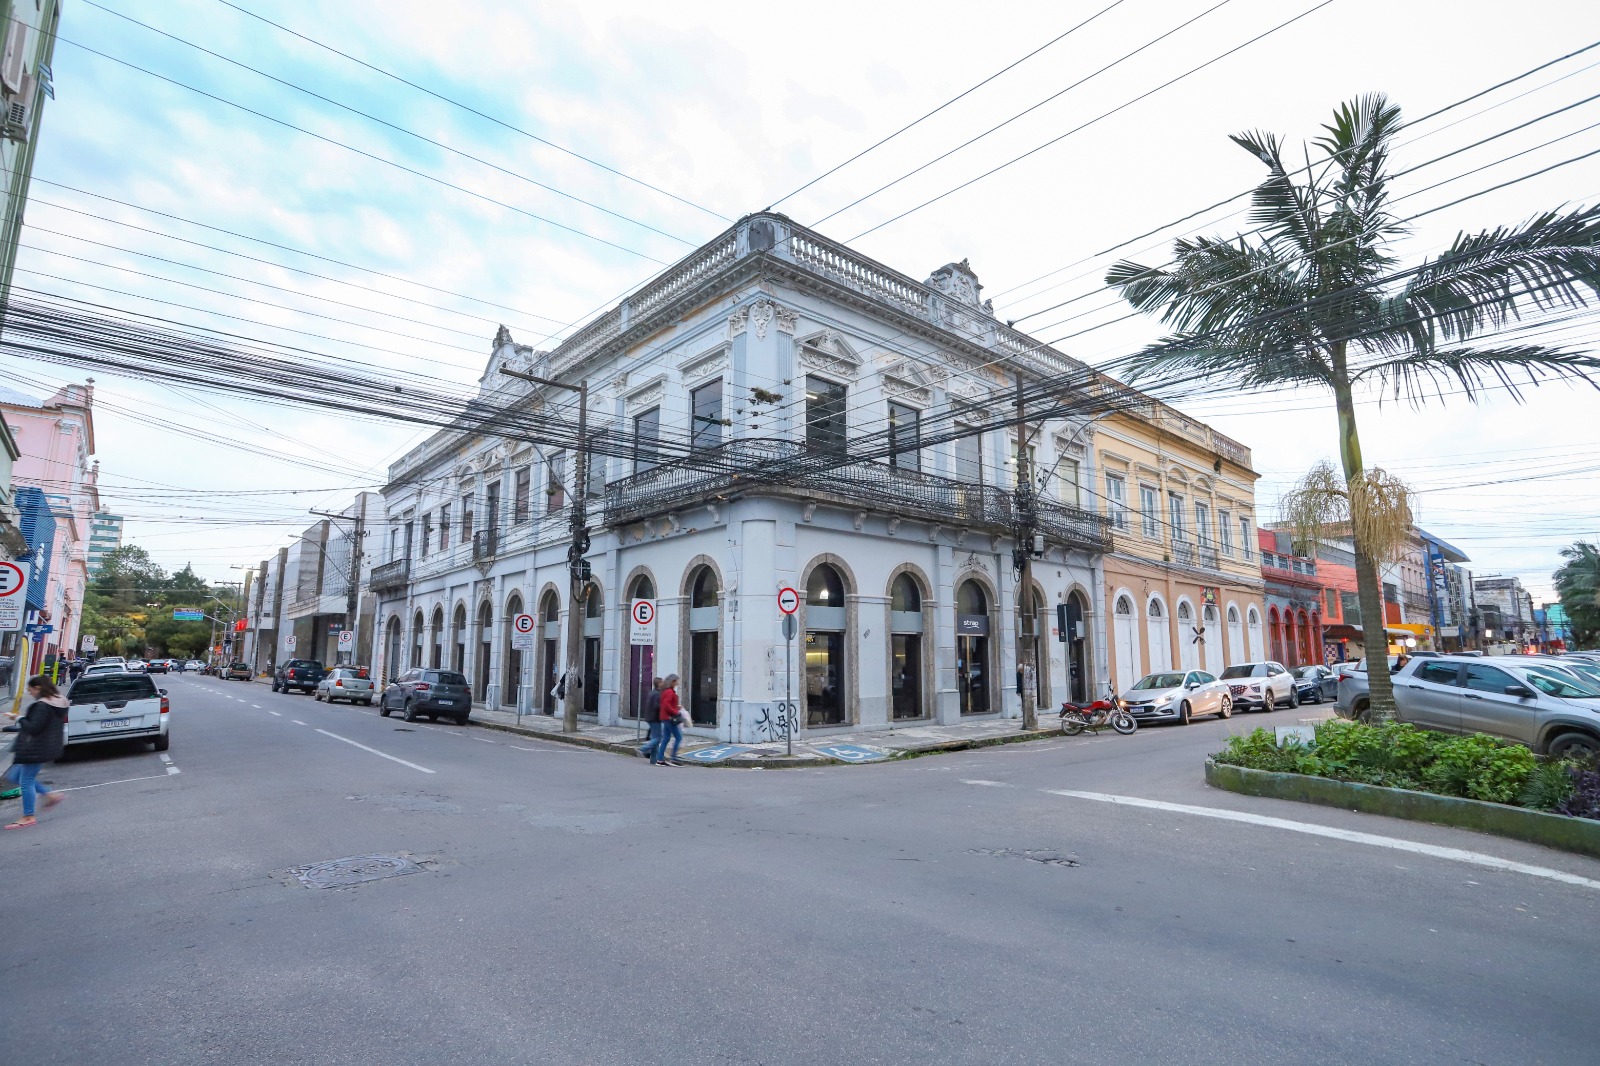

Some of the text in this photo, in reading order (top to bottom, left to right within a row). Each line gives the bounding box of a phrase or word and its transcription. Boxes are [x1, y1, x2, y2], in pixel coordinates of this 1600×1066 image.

[640, 605, 648, 619] E
[521, 618, 529, 629] E
[963, 619, 980, 629] strap
